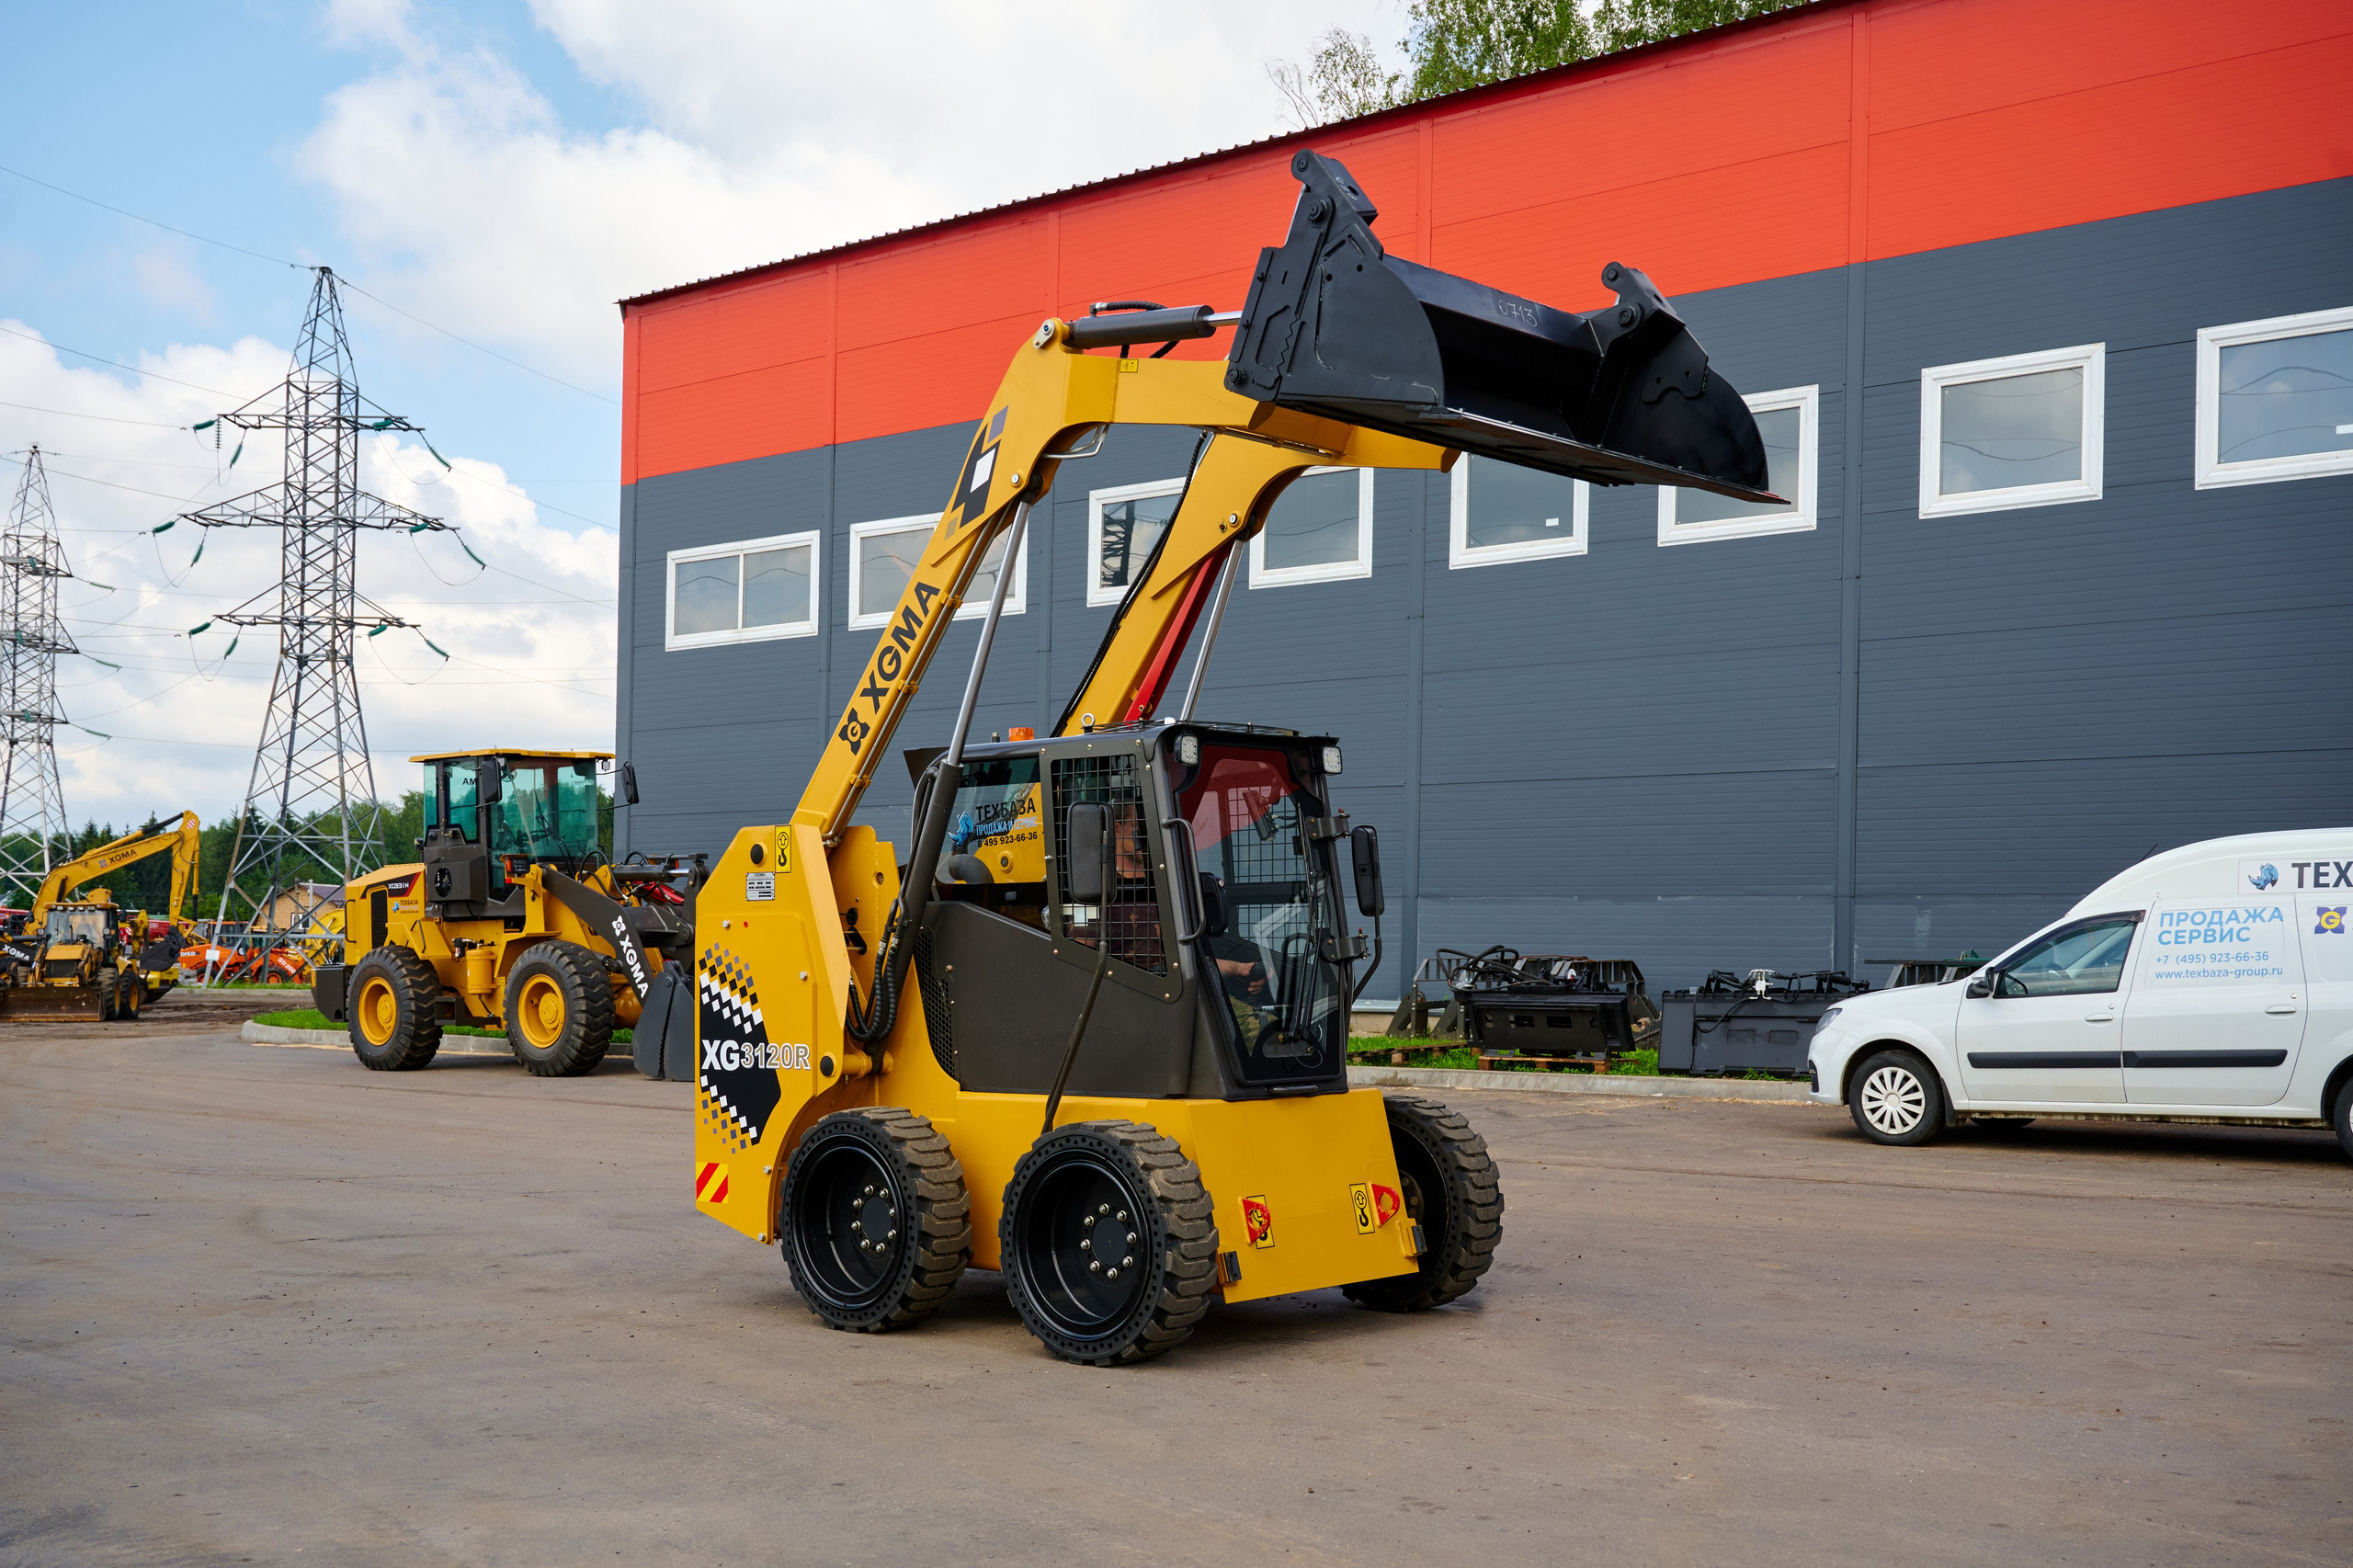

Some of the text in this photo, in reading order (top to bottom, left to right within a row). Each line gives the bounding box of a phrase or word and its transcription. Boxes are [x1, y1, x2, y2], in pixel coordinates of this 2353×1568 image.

[1498, 300, 1538, 327] 0713
[859, 581, 941, 715] XGMA
[975, 797, 1037, 822] ТЕХБАЗА
[976, 821, 1007, 836] ПРОДАЖА
[1014, 816, 1038, 830] СЕРВИС
[977, 831, 1038, 848] 8 495 923-66-36
[108, 848, 137, 864] XGMA
[2159, 906, 2284, 927] ПРОДАЖА
[2157, 926, 2251, 946] СЕРВИС
[2, 944, 30, 960] XGMA
[2155, 951, 2269, 965] +7 (495) 923-66-36
[620, 933, 649, 999] XGMA
[2154, 966, 2283, 979] www.texbaza-group.ru
[700, 1040, 812, 1072] XG3120R
